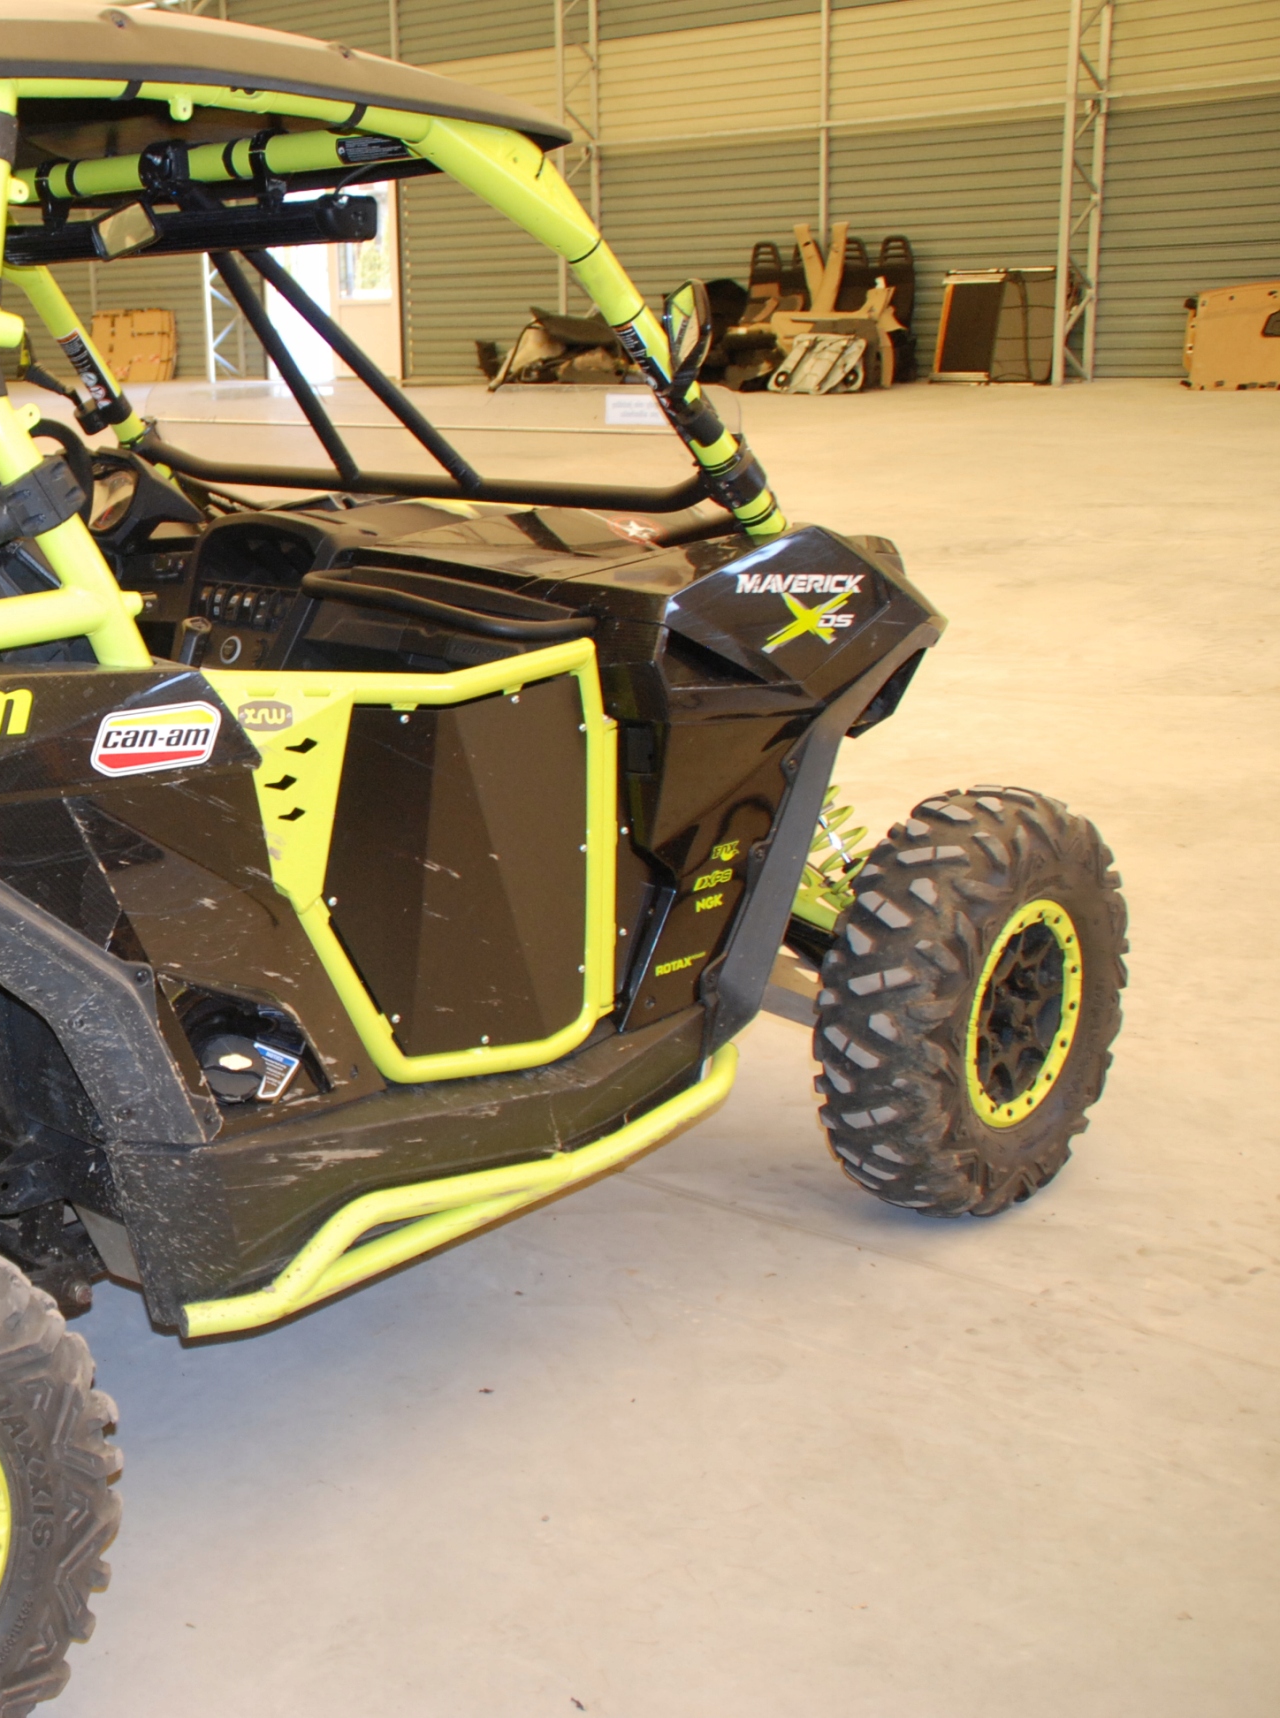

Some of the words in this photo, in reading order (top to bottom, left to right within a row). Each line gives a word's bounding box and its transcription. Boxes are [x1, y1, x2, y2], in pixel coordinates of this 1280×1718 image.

[735, 573, 865, 594] MAVERICK
[102, 727, 211, 749] can-am
[711, 840, 740, 861] FOX
[695, 893, 723, 912] NGK
[655, 957, 692, 976] ROTAX
